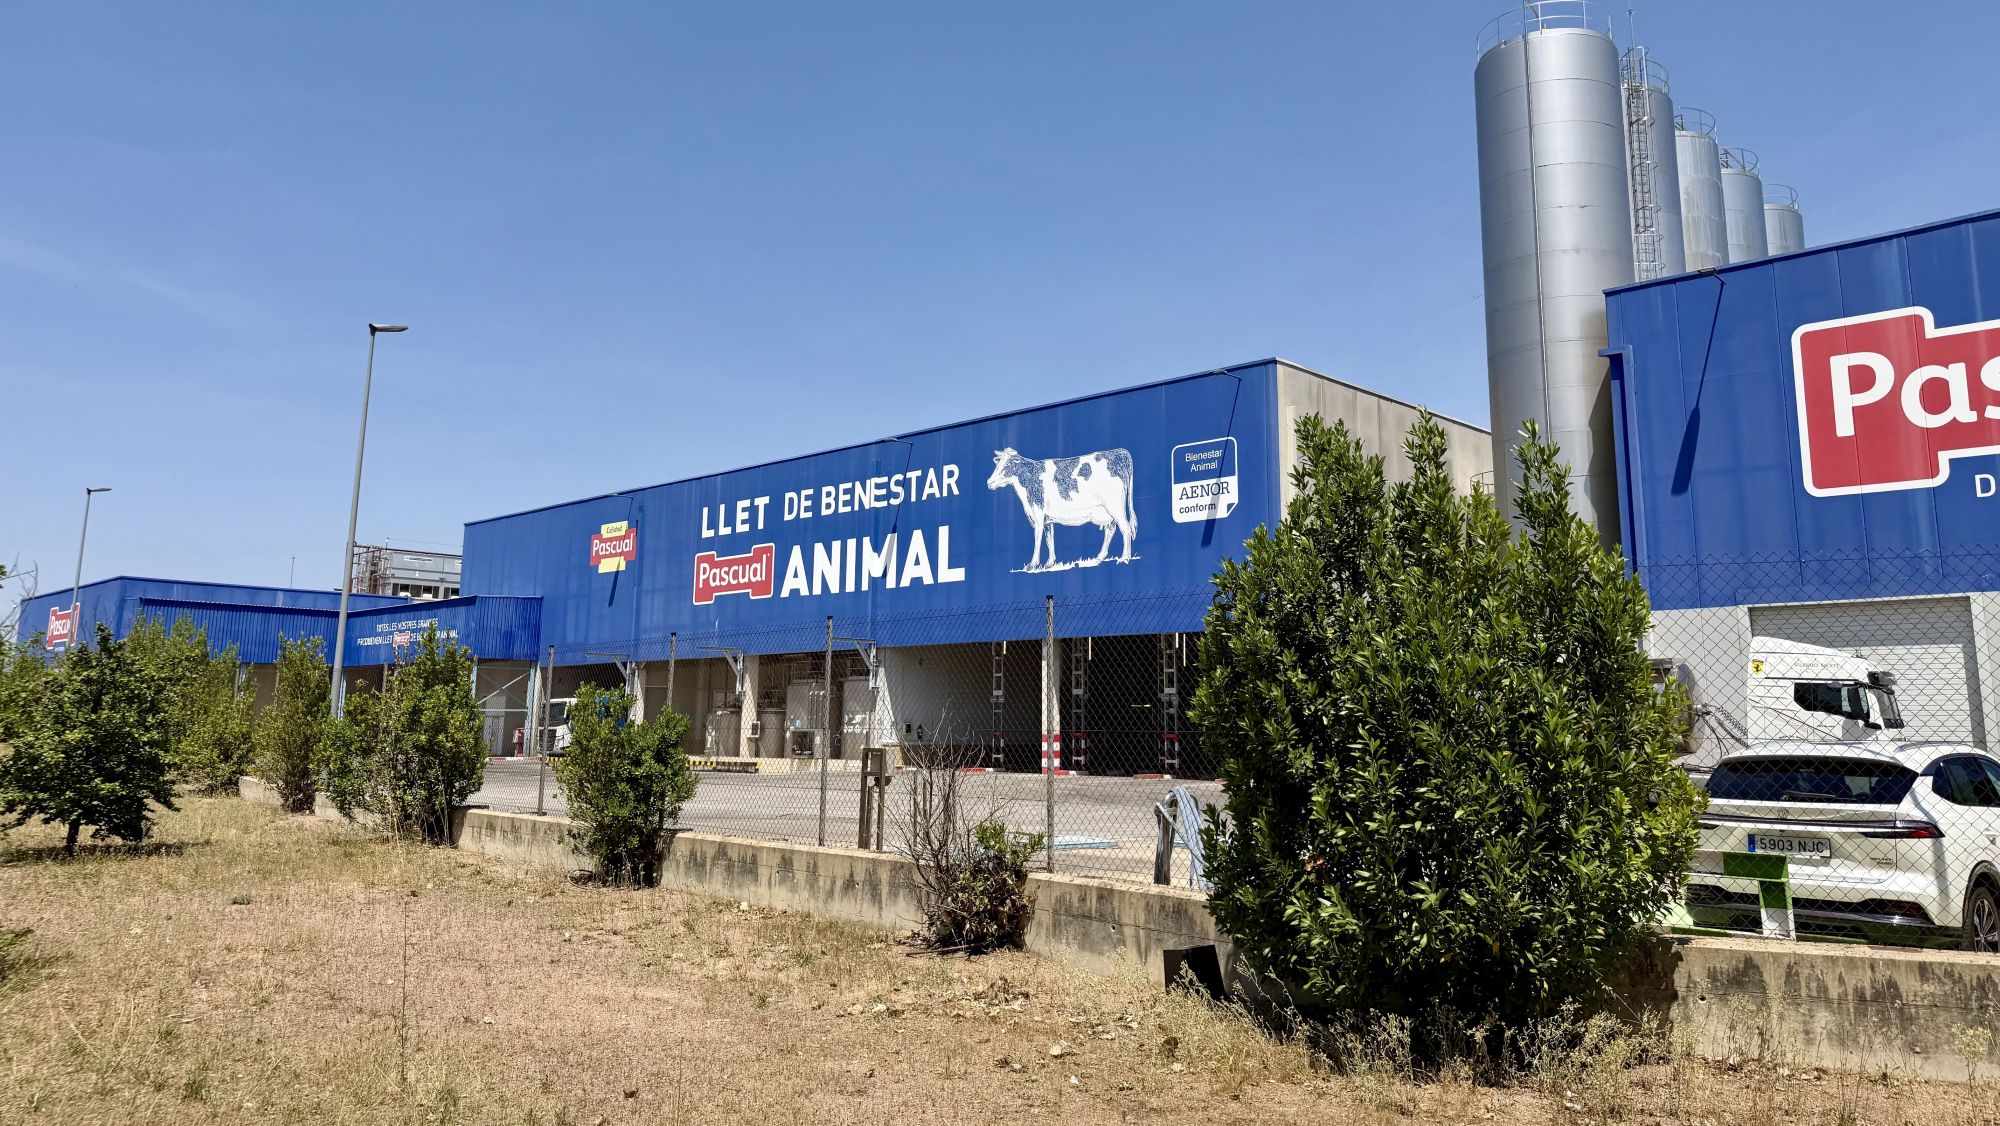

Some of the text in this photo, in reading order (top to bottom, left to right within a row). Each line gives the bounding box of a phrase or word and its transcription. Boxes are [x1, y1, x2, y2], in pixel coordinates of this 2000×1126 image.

[1185, 449, 1223, 462] Bienestar
[1190, 460, 1218, 472] Animal
[1178, 481, 1231, 500] AENOR
[701, 463, 961, 539] LLET DE BENESTAR
[1179, 503, 1217, 514] conform
[592, 533, 634, 557] Pascual
[698, 552, 768, 589] Pascual
[780, 525, 966, 598] ANIMAL
[1760, 838, 1824, 853] 5903 NJC
